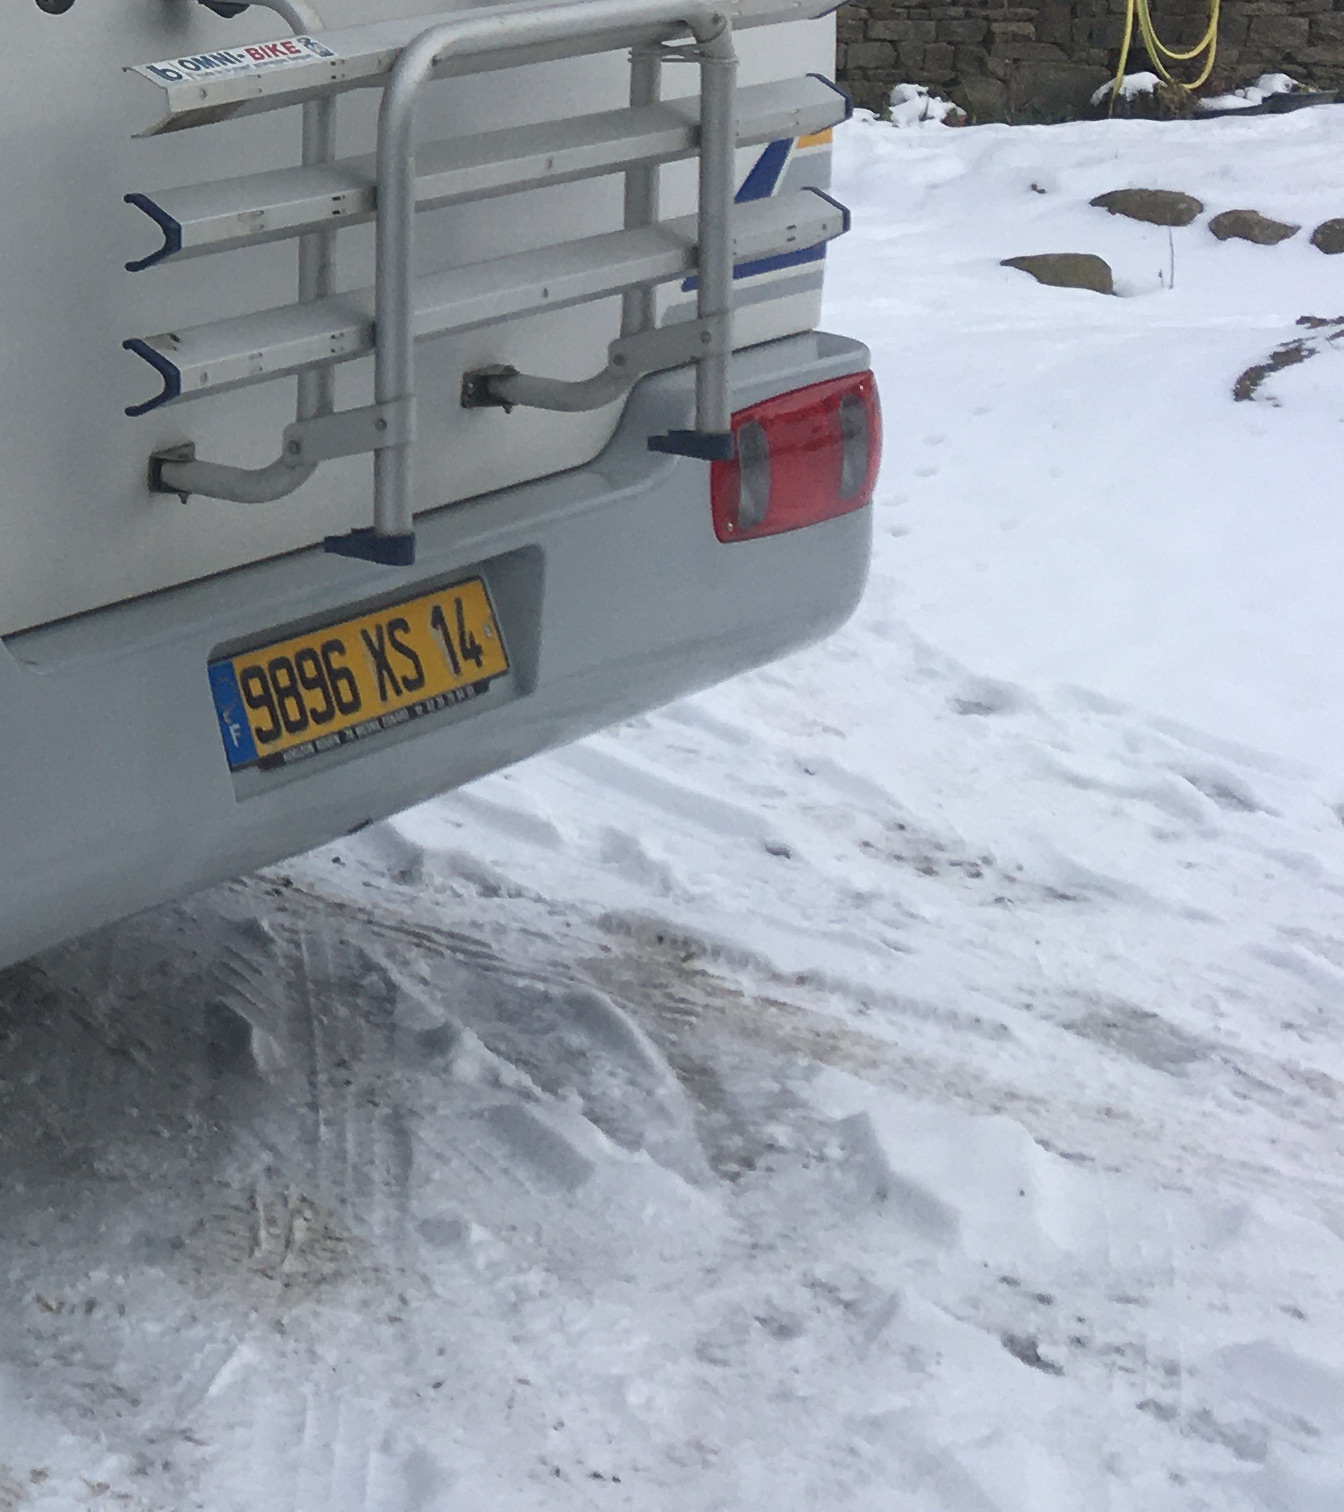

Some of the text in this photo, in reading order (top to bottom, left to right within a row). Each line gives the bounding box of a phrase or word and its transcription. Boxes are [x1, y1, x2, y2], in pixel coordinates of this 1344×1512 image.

[239, 638, 362, 745] 9896
[360, 617, 426, 702] XS
[429, 596, 484, 677] 14
